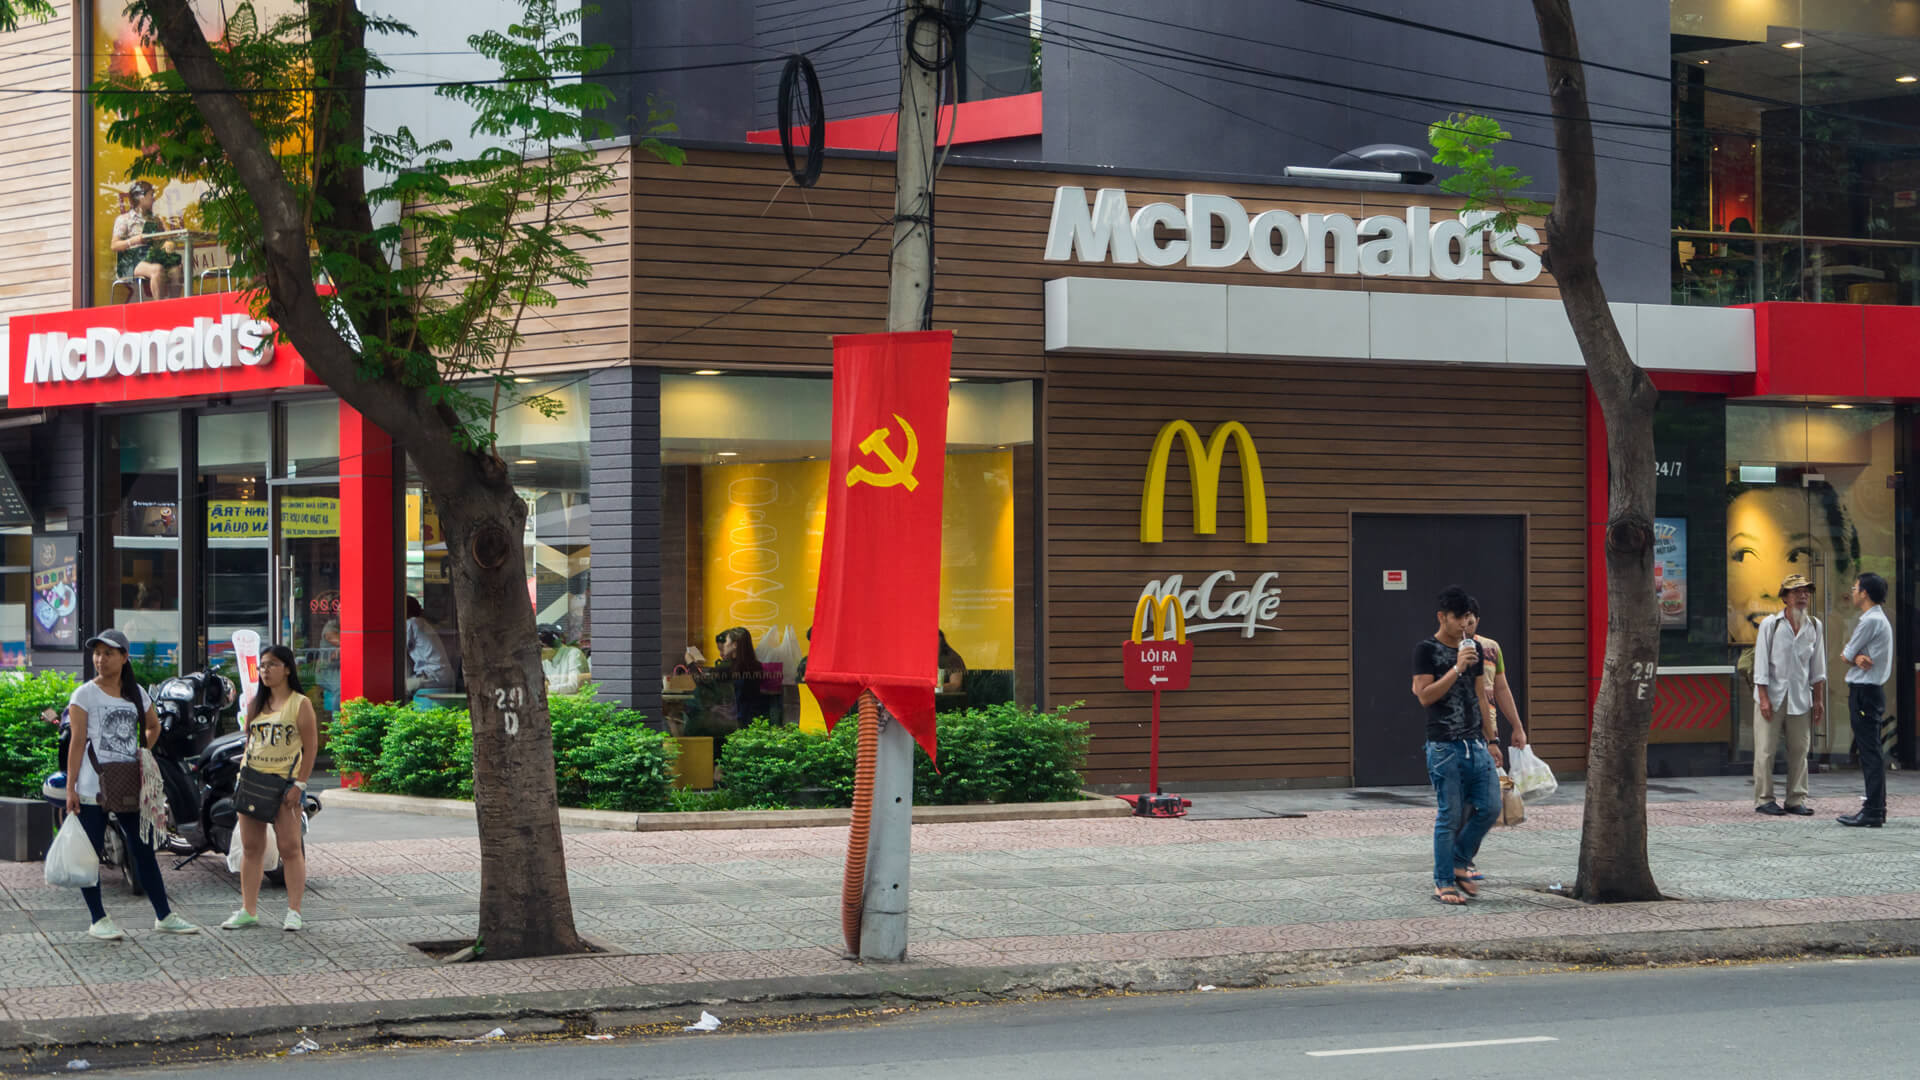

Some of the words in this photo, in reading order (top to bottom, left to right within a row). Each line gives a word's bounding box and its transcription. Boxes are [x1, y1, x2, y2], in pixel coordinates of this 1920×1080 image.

[1043, 185, 1546, 284] McDonald's
[23, 313, 274, 384] McDonald's
[1135, 570, 1282, 639] McCafé
[1162, 650, 1177, 663] RA
[1631, 661, 1654, 680] 29
[1637, 682, 1649, 700] E
[504, 711, 519, 735] D
